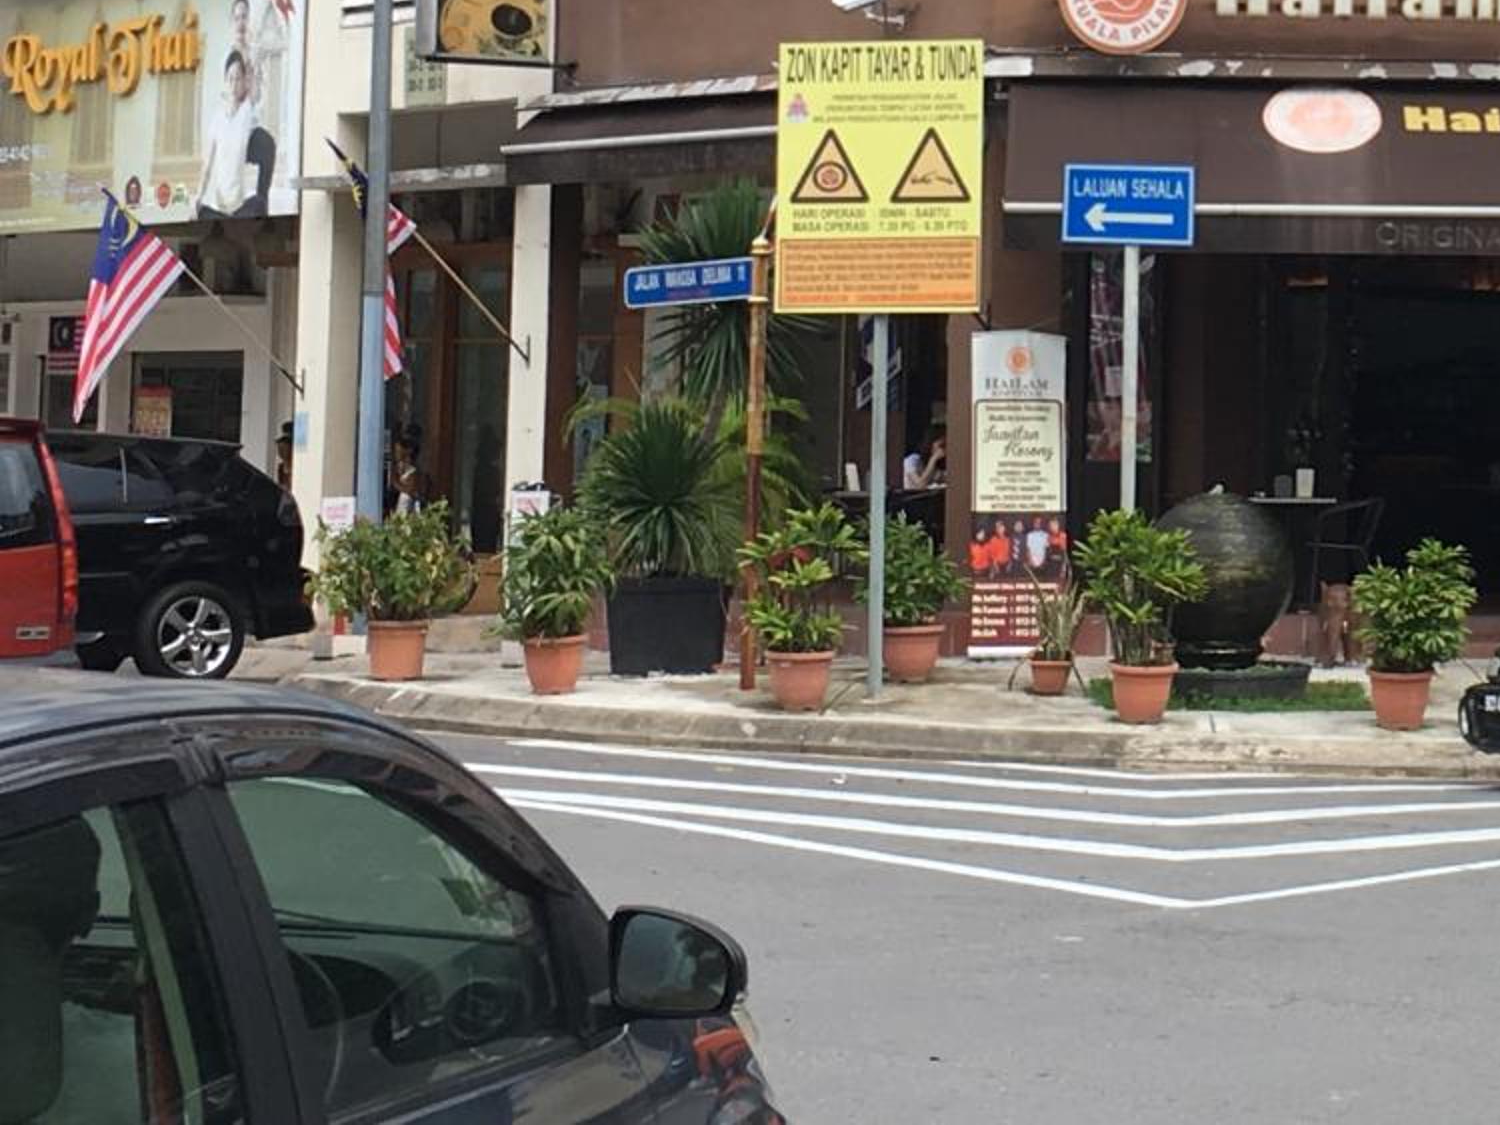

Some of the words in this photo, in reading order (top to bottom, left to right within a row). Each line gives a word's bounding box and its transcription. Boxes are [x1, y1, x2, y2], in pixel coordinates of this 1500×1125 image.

[4, 19, 107, 114] Royal
[107, 6, 202, 98] Thai
[787, 47, 816, 83] ZON
[821, 47, 862, 82] KAPIT
[867, 46, 911, 82] TAYAR
[916, 46, 924, 81] &
[929, 44, 977, 81] TUNDA
[1073, 177, 1126, 198] LALUAN
[1132, 178, 1184, 199] SEHALA
